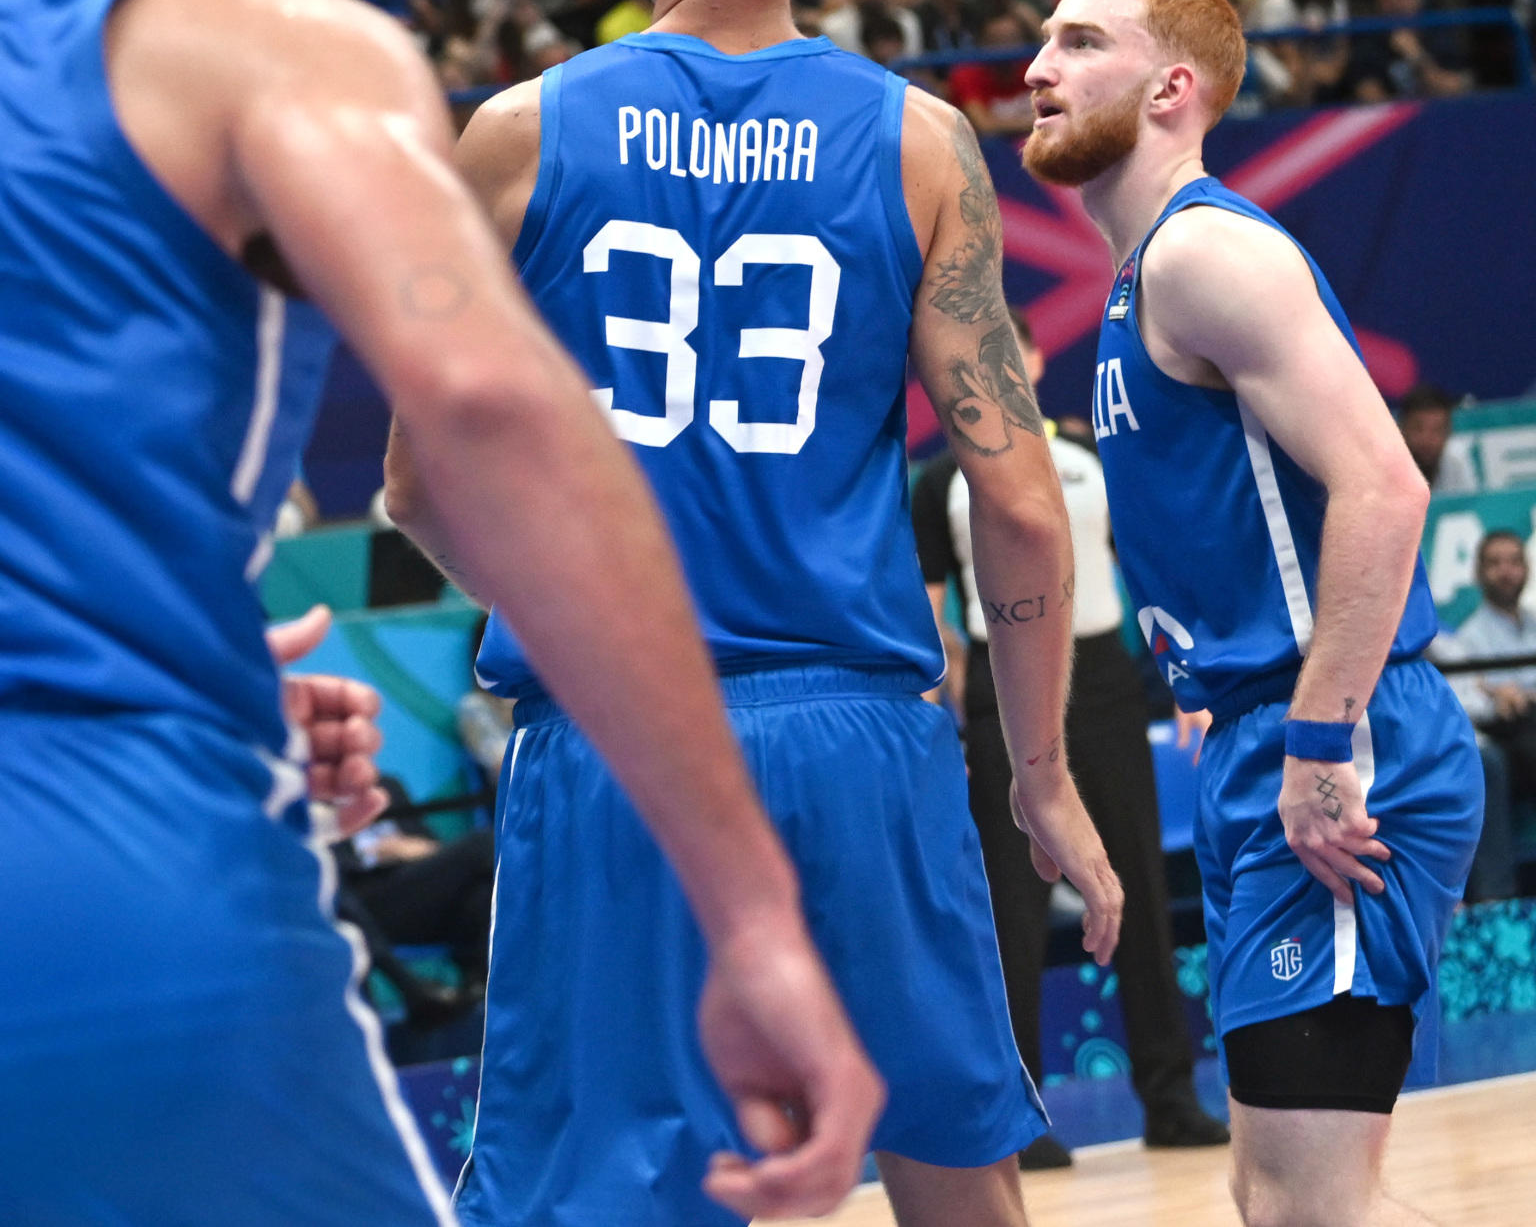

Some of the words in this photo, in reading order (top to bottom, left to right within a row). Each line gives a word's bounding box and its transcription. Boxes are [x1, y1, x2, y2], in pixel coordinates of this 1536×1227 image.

[619, 106, 818, 184] POLONARA
[583, 219, 841, 454] 33
[1092, 359, 1141, 442] IA
